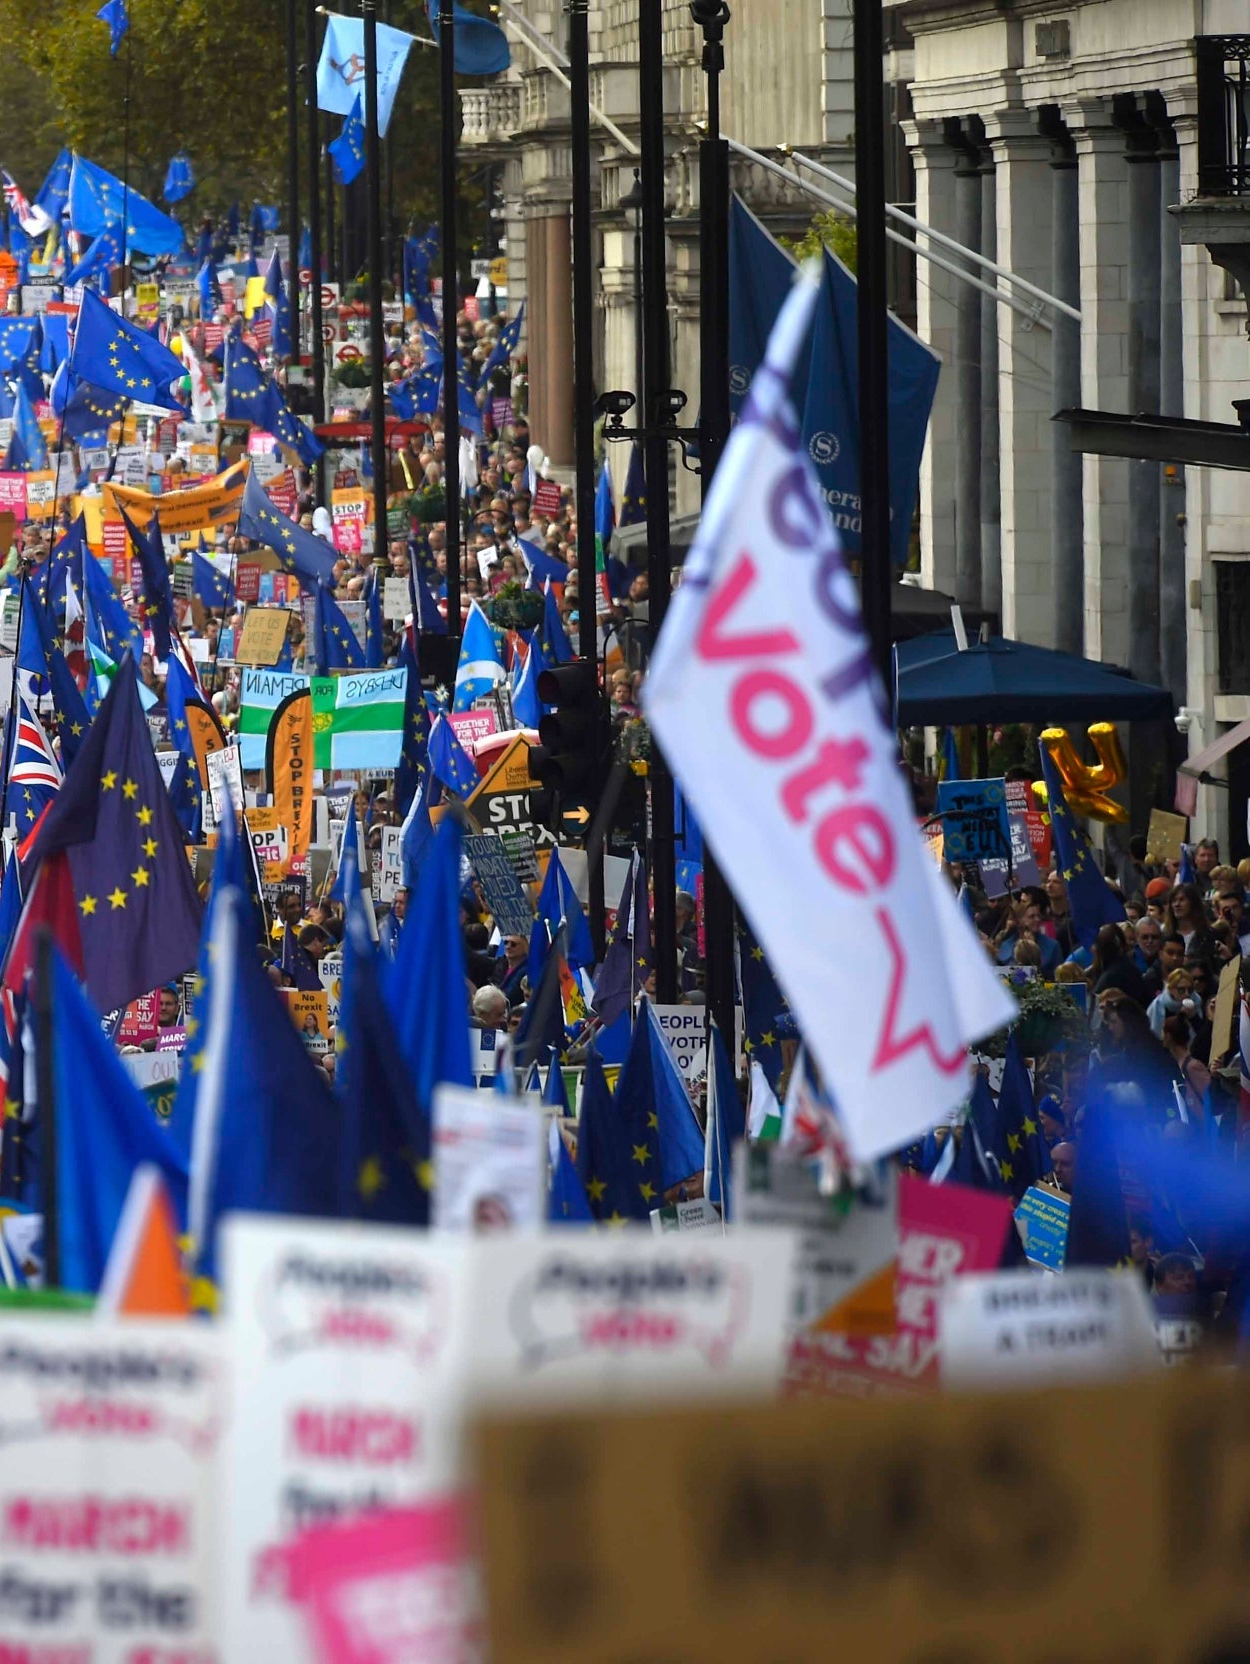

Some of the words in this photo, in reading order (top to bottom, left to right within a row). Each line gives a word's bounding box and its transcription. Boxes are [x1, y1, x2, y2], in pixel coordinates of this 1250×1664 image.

[334, 504, 362, 515] STOP
[453, 720, 490, 730] TOGETHER
[457, 729, 473, 738] FOR
[474, 727, 489, 736] THE
[290, 734, 303, 782] STOP
[301, 993, 315, 1002] No
[294, 1003, 322, 1012] Brexit
[137, 1011, 154, 1022] SAY
[680, 1206, 704, 1218] Green
[0, 1498, 190, 1556] MARCH
[97, 1563, 194, 1630] the
